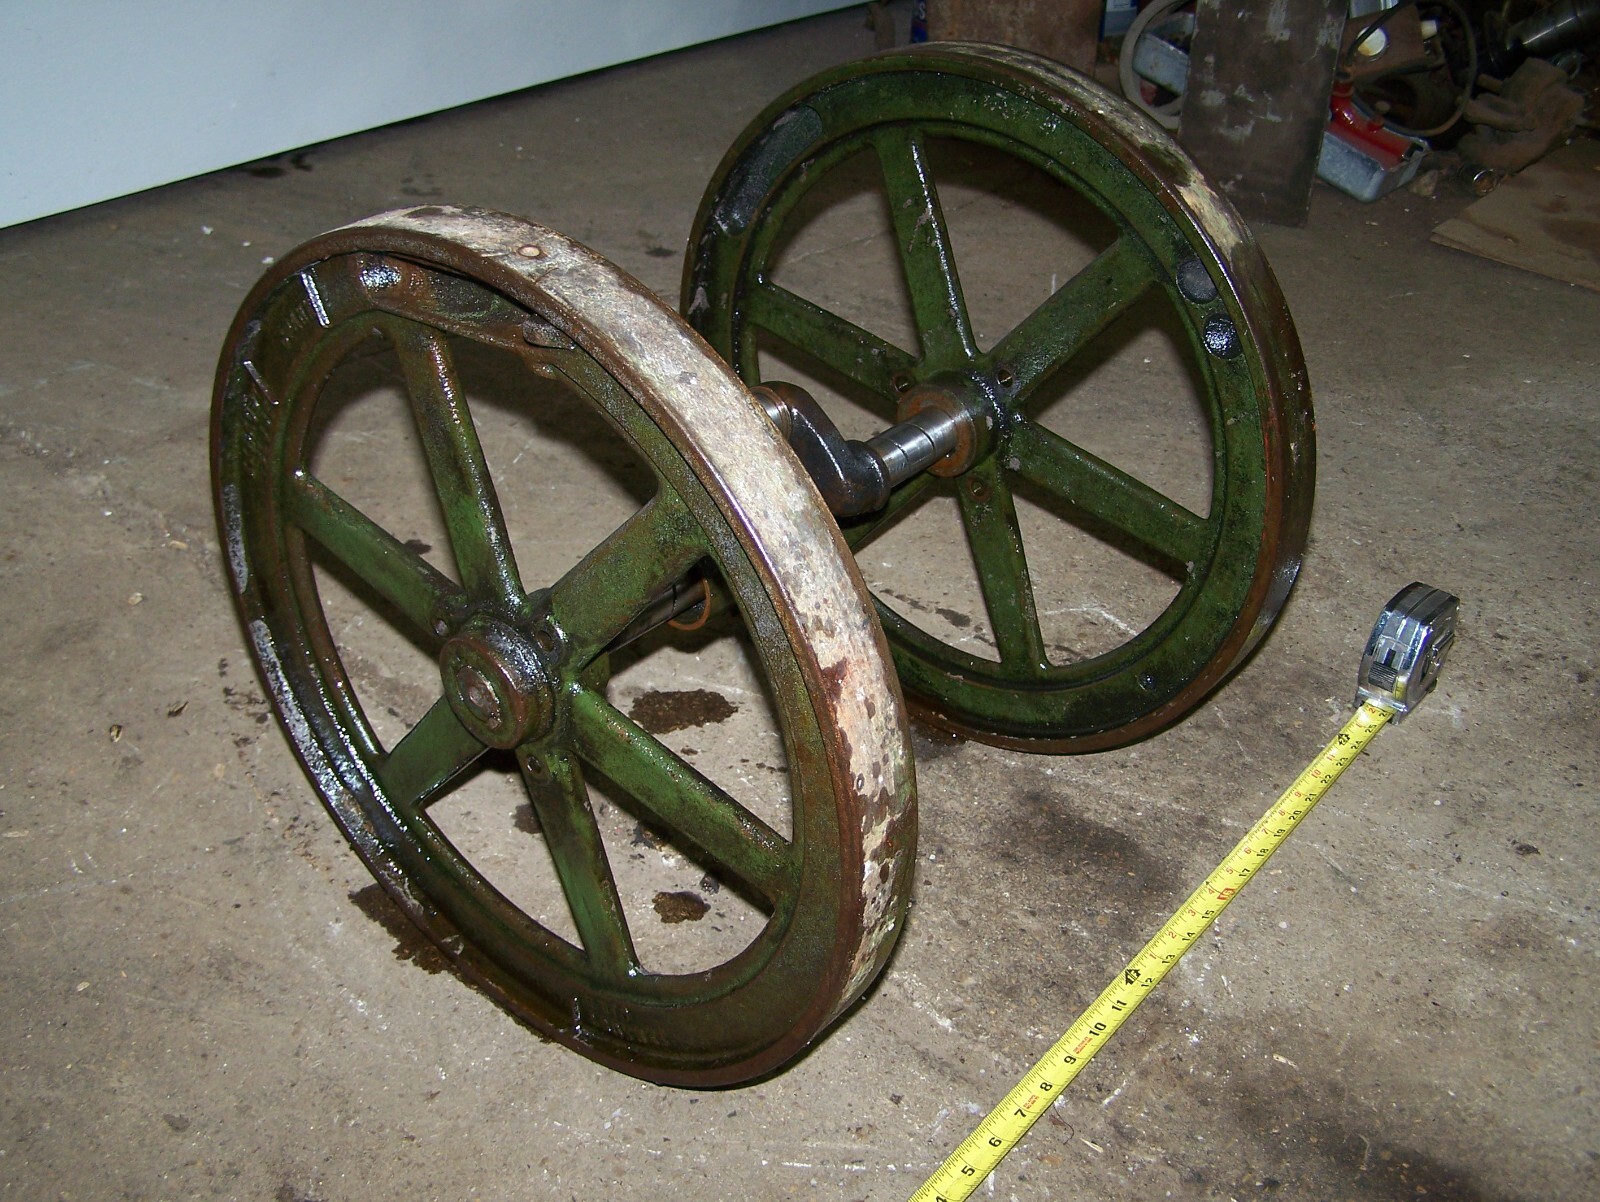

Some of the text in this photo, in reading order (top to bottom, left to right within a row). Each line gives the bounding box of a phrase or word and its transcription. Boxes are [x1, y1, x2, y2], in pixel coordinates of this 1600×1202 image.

[1364, 724, 1377, 734] 25
[1350, 740, 1363, 750] 24
[1336, 757, 1348, 767] 23
[1311, 769, 1322, 779] 10
[1320, 774, 1333, 784] 22
[1304, 793, 1317, 802] 21
[1278, 809, 1286, 817] 8
[1288, 810, 1302, 821] 20
[1261, 828, 1269, 836] 7
[1273, 828, 1286, 838] 19
[1243, 847, 1252, 855] 6
[1256, 848, 1269, 857] 18
[1225, 867, 1234, 875] 5
[1238, 868, 1250, 877] 17
[1187, 908, 1196, 917] 3
[1201, 909, 1215, 919] 15
[1168, 931, 1177, 939] 2
[1182, 931, 1195, 941] 14
[1149, 952, 1157, 960] 1
[1162, 954, 1175, 964] 13
[1141, 977, 1155, 988] 12
[1111, 999, 1127, 1012] 11
[1088, 1022, 1107, 1037] 10
[1064, 1055, 1076, 1065] 9
[1039, 1081, 1052, 1092] 8
[1014, 1108, 1027, 1118] 7
[988, 1136, 1002, 1147] 6
[961, 1165, 975, 1176] 5
